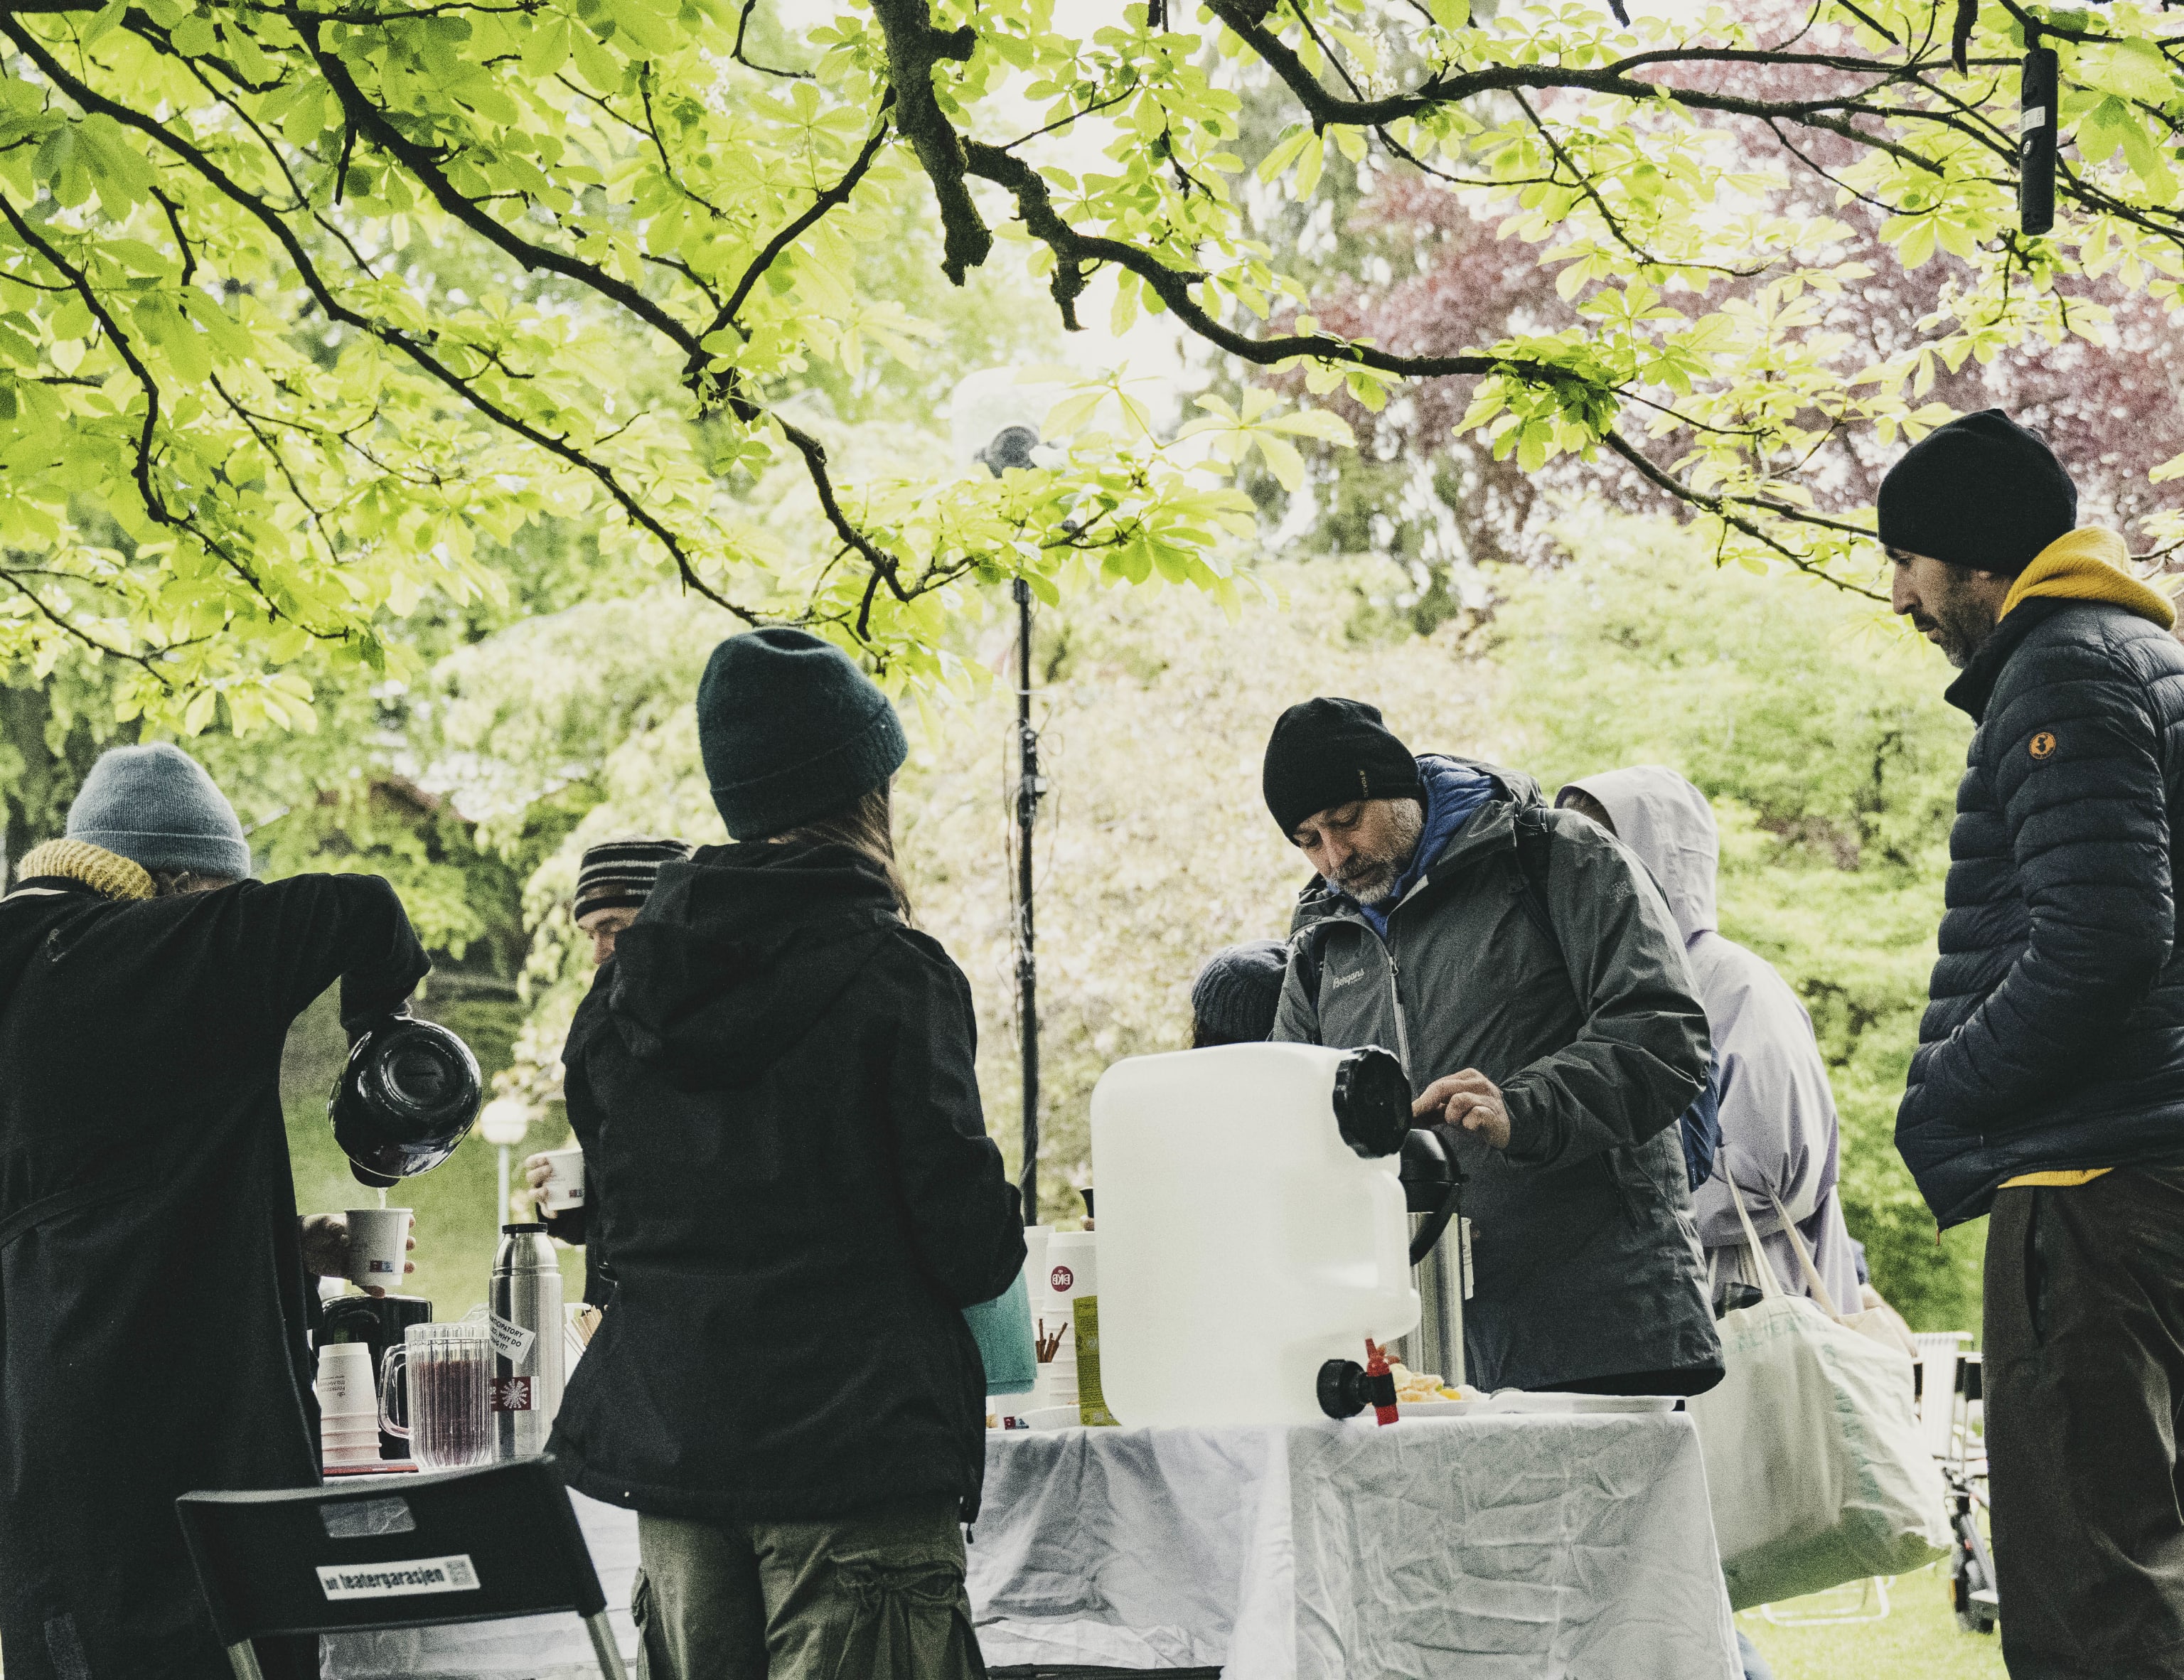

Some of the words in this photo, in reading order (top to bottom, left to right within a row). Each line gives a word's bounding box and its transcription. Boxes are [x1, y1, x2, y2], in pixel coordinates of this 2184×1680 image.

[1332, 968, 1364, 990] Bergans
[489, 1313, 524, 1338] ARTICIPATORY
[498, 1331, 511, 1342] WHY
[511, 1339, 522, 1347] DO
[499, 1342, 508, 1351] IT?
[338, 1566, 445, 1590] teatergarasjen
